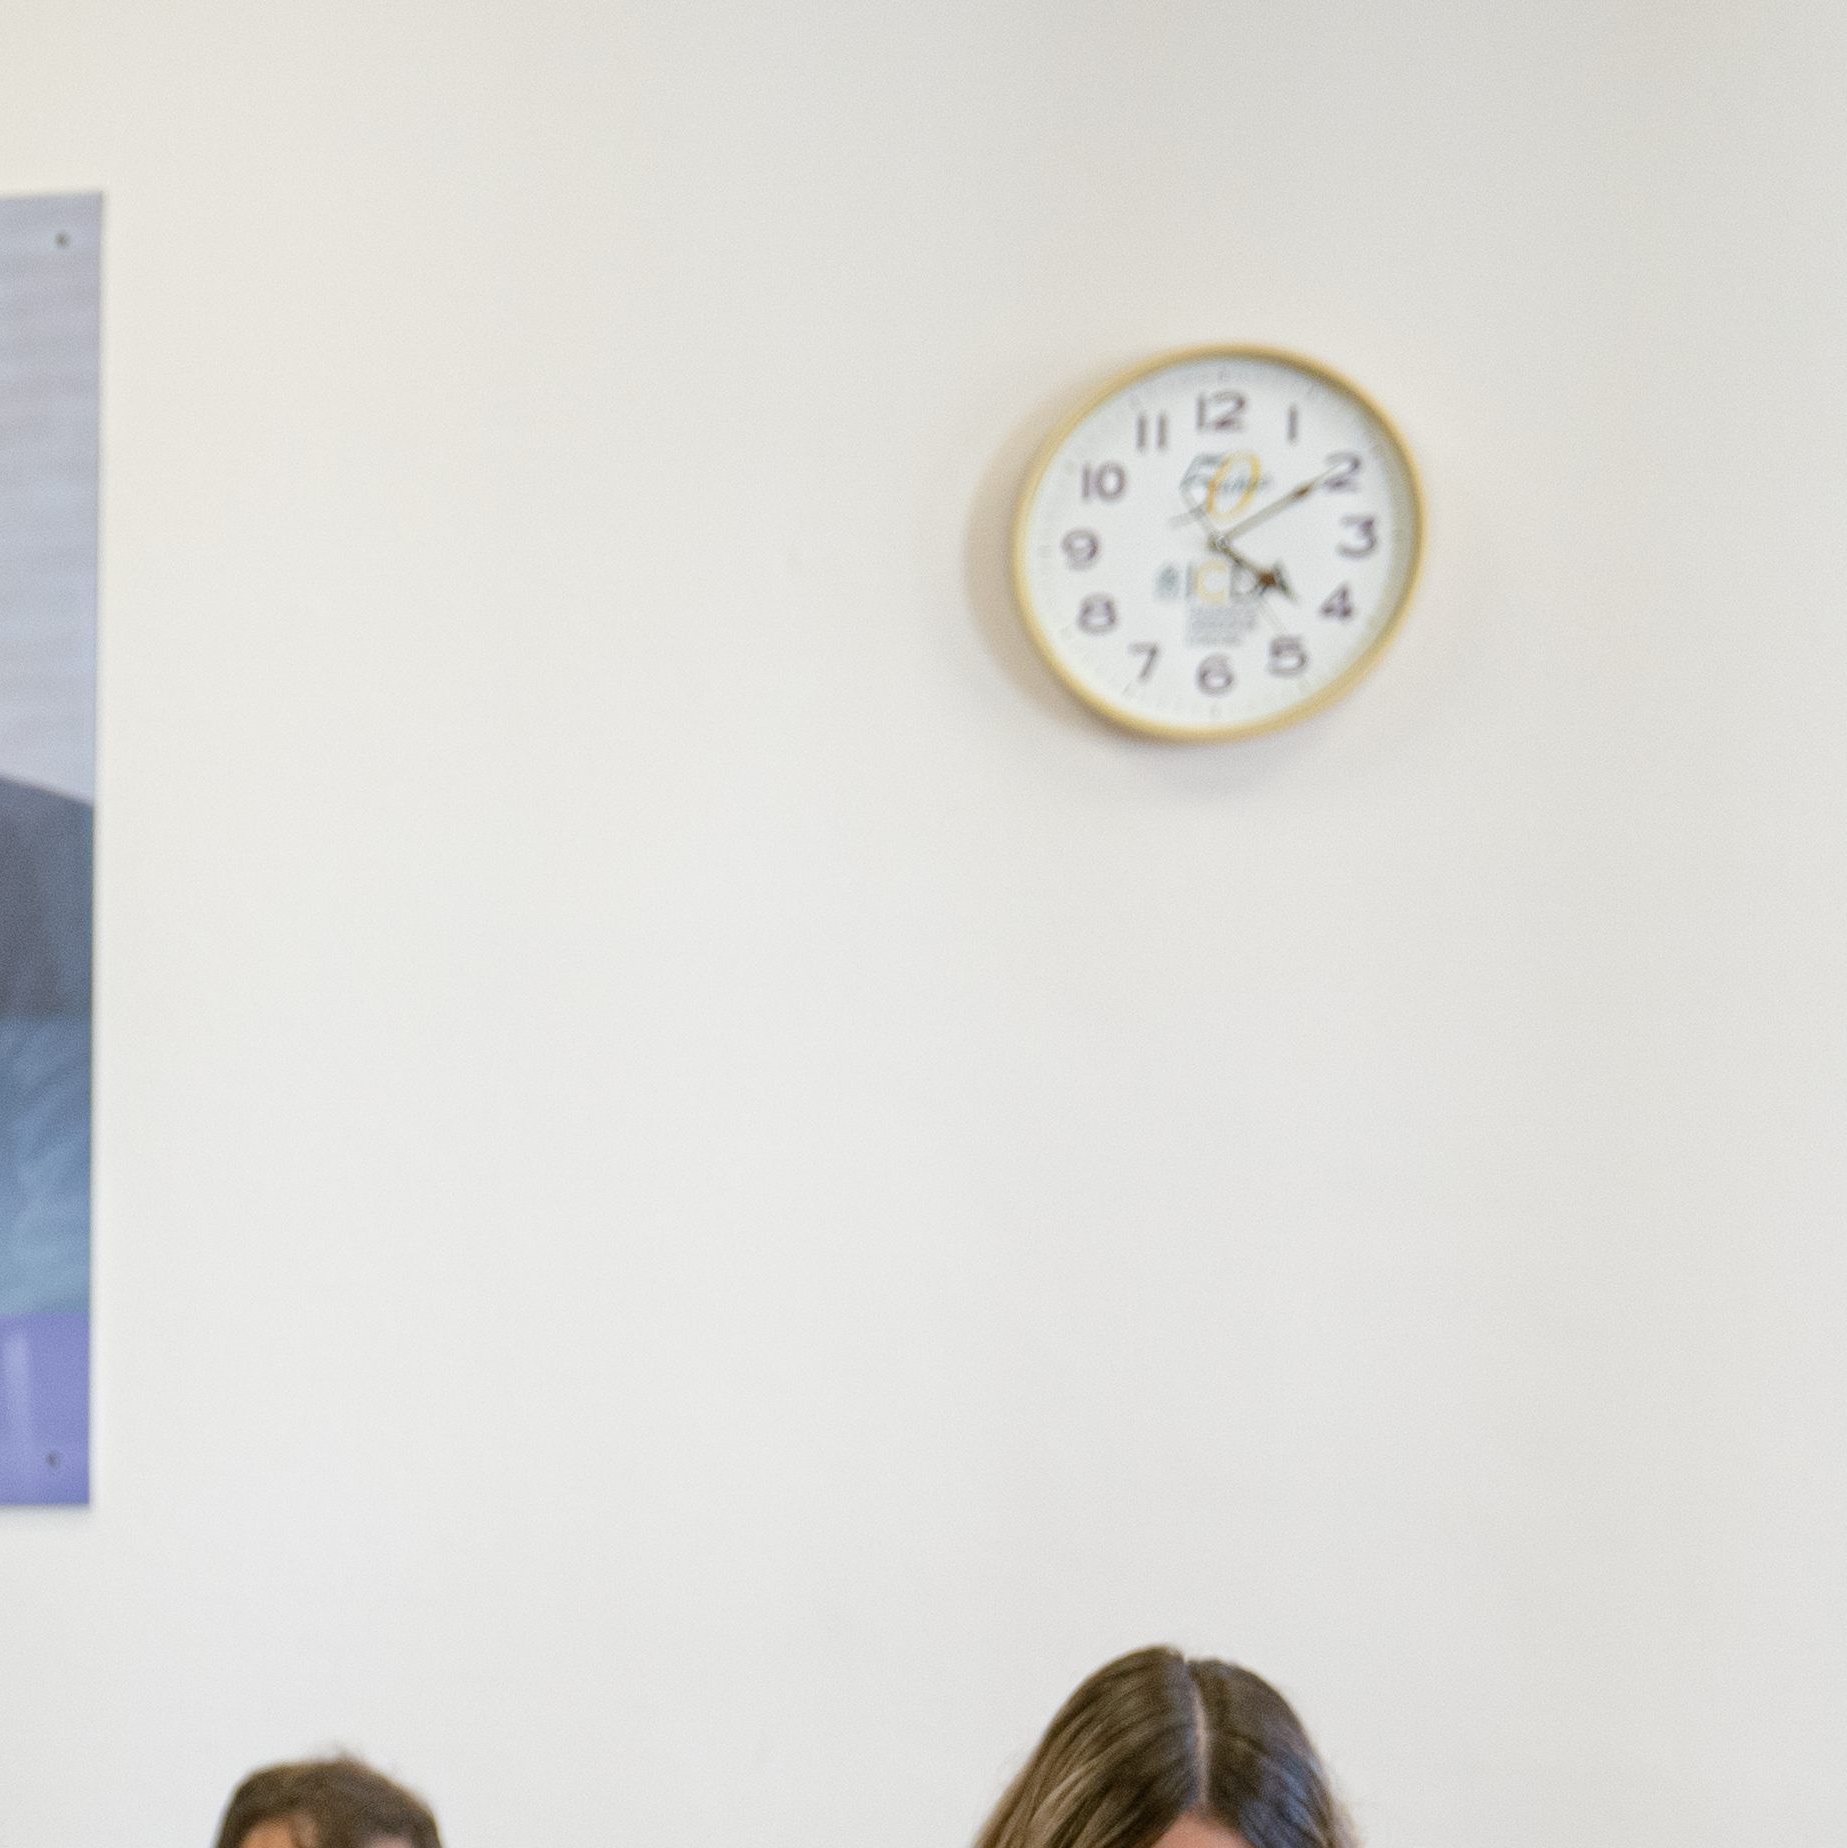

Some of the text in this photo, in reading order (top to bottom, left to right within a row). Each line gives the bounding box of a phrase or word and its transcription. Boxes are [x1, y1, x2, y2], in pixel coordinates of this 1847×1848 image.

[1135, 412, 1170, 450] 11
[1195, 390, 1247, 433] 12
[1286, 403, 1299, 443] 1
[1081, 461, 1128, 502] 10
[1322, 450, 1363, 493] 2
[1061, 528, 1100, 570] 9
[1335, 514, 1379, 559] 3
[1077, 593, 1118, 634] 8
[1318, 583, 1354, 621] 4
[1128, 641, 1161, 682] 7
[1196, 653, 1236, 696] 6
[1267, 636, 1310, 678] 5
